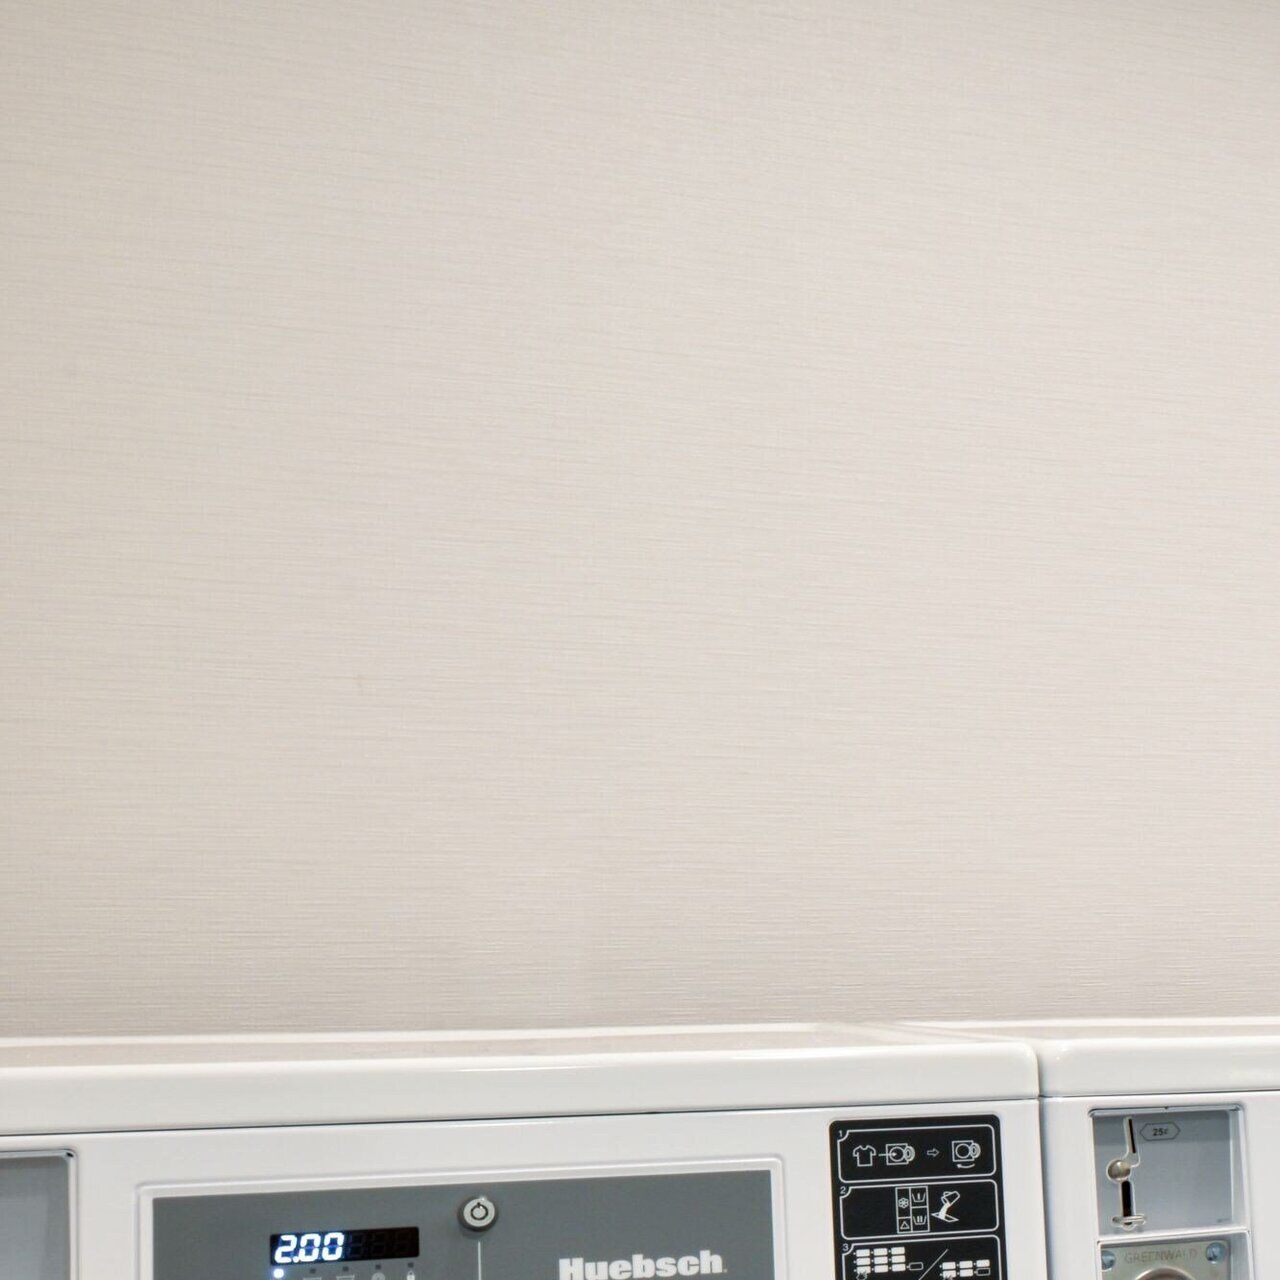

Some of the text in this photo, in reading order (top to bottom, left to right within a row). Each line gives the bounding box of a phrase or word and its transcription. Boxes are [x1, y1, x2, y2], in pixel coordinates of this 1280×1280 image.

[840, 1186, 846, 1195] 2
[274, 1231, 344, 1263] 2.00
[843, 1243, 849, 1252] 3
